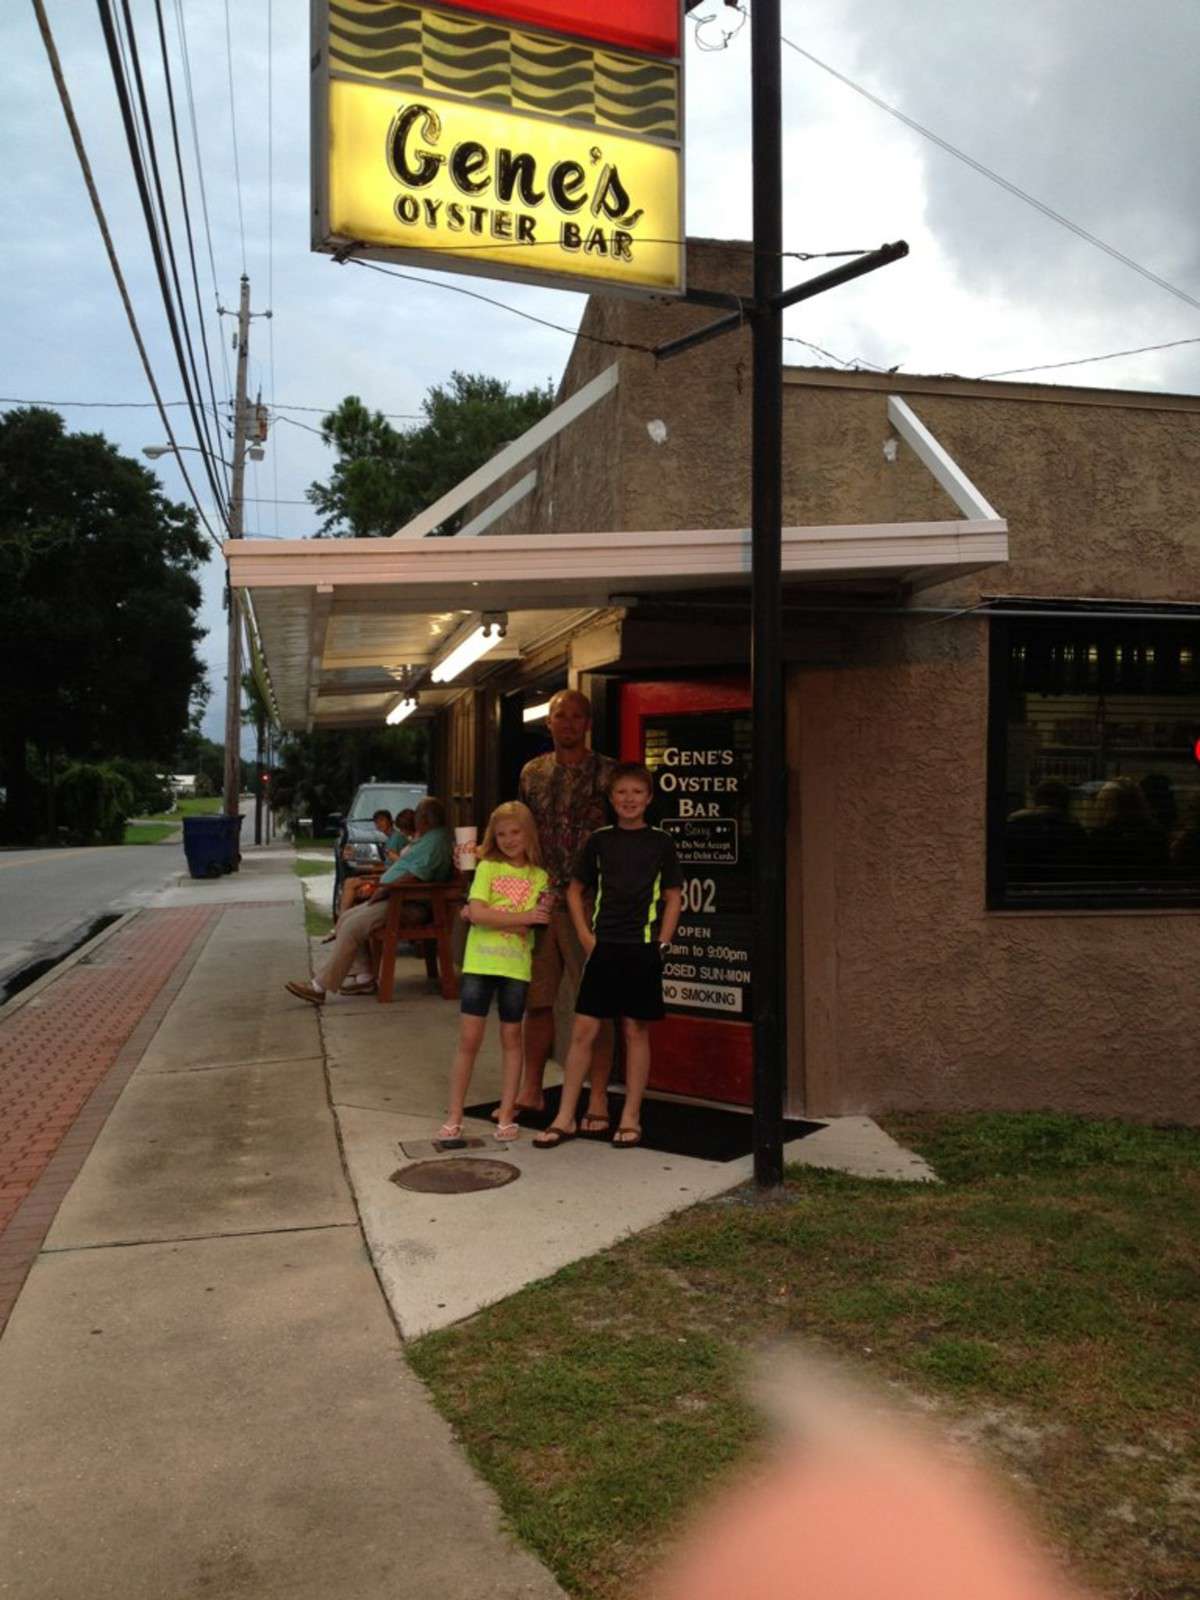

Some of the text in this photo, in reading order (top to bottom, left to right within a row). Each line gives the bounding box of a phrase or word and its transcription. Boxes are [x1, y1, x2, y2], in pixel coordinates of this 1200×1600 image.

[386, 104, 644, 229] Gene's
[394, 193, 634, 262] OYSTER BAR
[660, 772, 739, 792] OYSTER
[679, 798, 720, 817] BAR
[678, 926, 711, 938] OPEN
[693, 945, 704, 957] to
[707, 945, 748, 963] 9:00pm
[662, 963, 696, 978] OSED
[681, 987, 736, 1006] SMOKING
